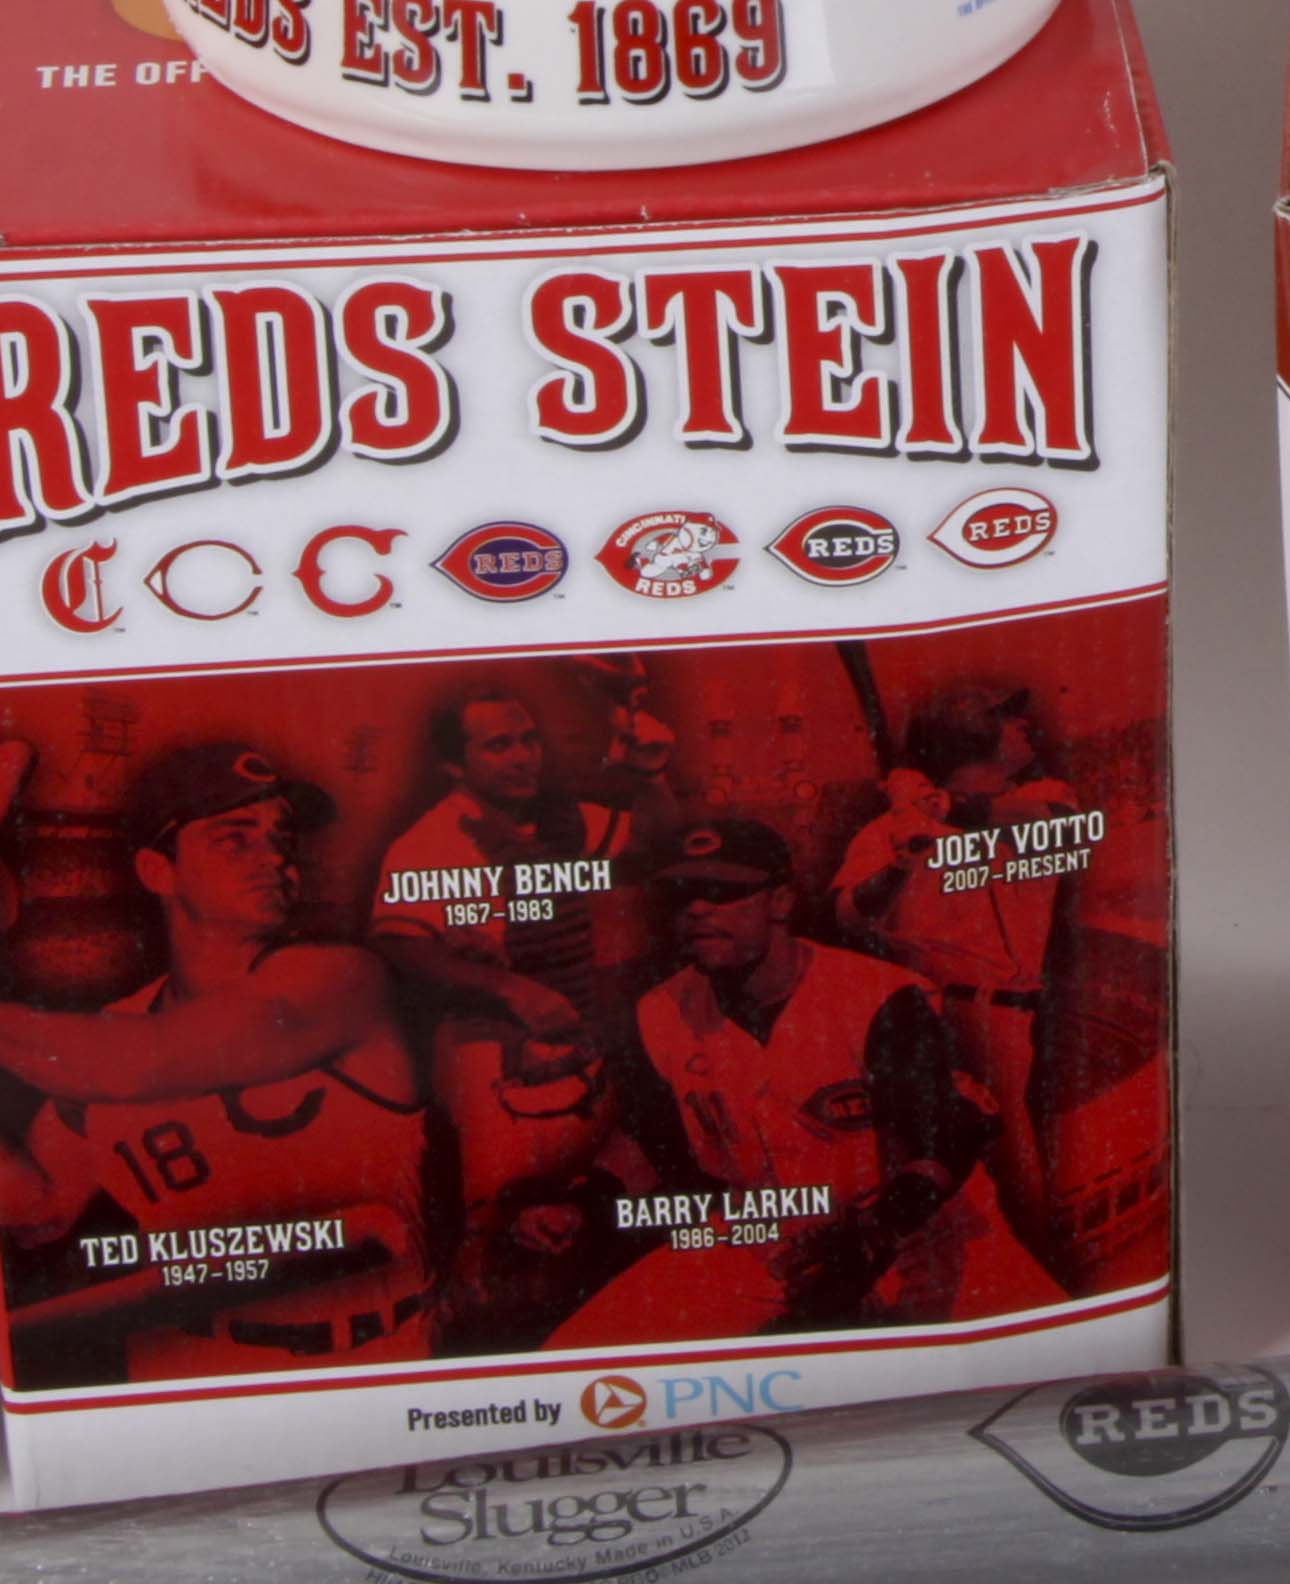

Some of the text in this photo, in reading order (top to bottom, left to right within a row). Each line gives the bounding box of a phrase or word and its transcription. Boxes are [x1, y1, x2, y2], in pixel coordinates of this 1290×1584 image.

[37, 64, 119, 90] THE
[0, 228, 1098, 538] REDS STEIN
[616, 513, 687, 547] CINCINNATI
[807, 533, 896, 560] REDS
[968, 512, 1052, 543] REDS
[473, 548, 564, 575] REDS
[635, 577, 696, 598] REDS
[927, 810, 1105, 869] JOEY VOTTO
[383, 859, 613, 904] JOHNNY BENCH
[942, 847, 1092, 894] 2007-PRESENT
[445, 898, 555, 927] 1967-1983
[114, 1120, 212, 1205] 18
[616, 1185, 832, 1228] BARRY LARKIN
[80, 1218, 346, 1267] TED KLUSZEWSKI
[670, 1221, 780, 1251] 1986-2004
[162, 1257, 271, 1287] 1947-1957
[407, 1369, 803, 1432] Presented by PNC
[1075, 1388, 1276, 1446] REDS
[395, 1428, 753, 1495] Louisville
[420, 1481, 707, 1548] Slugger
[496, 1552, 589, 1577] Kentucky
[595, 1542, 649, 1565] Made
[655, 1534, 675, 1548] in
